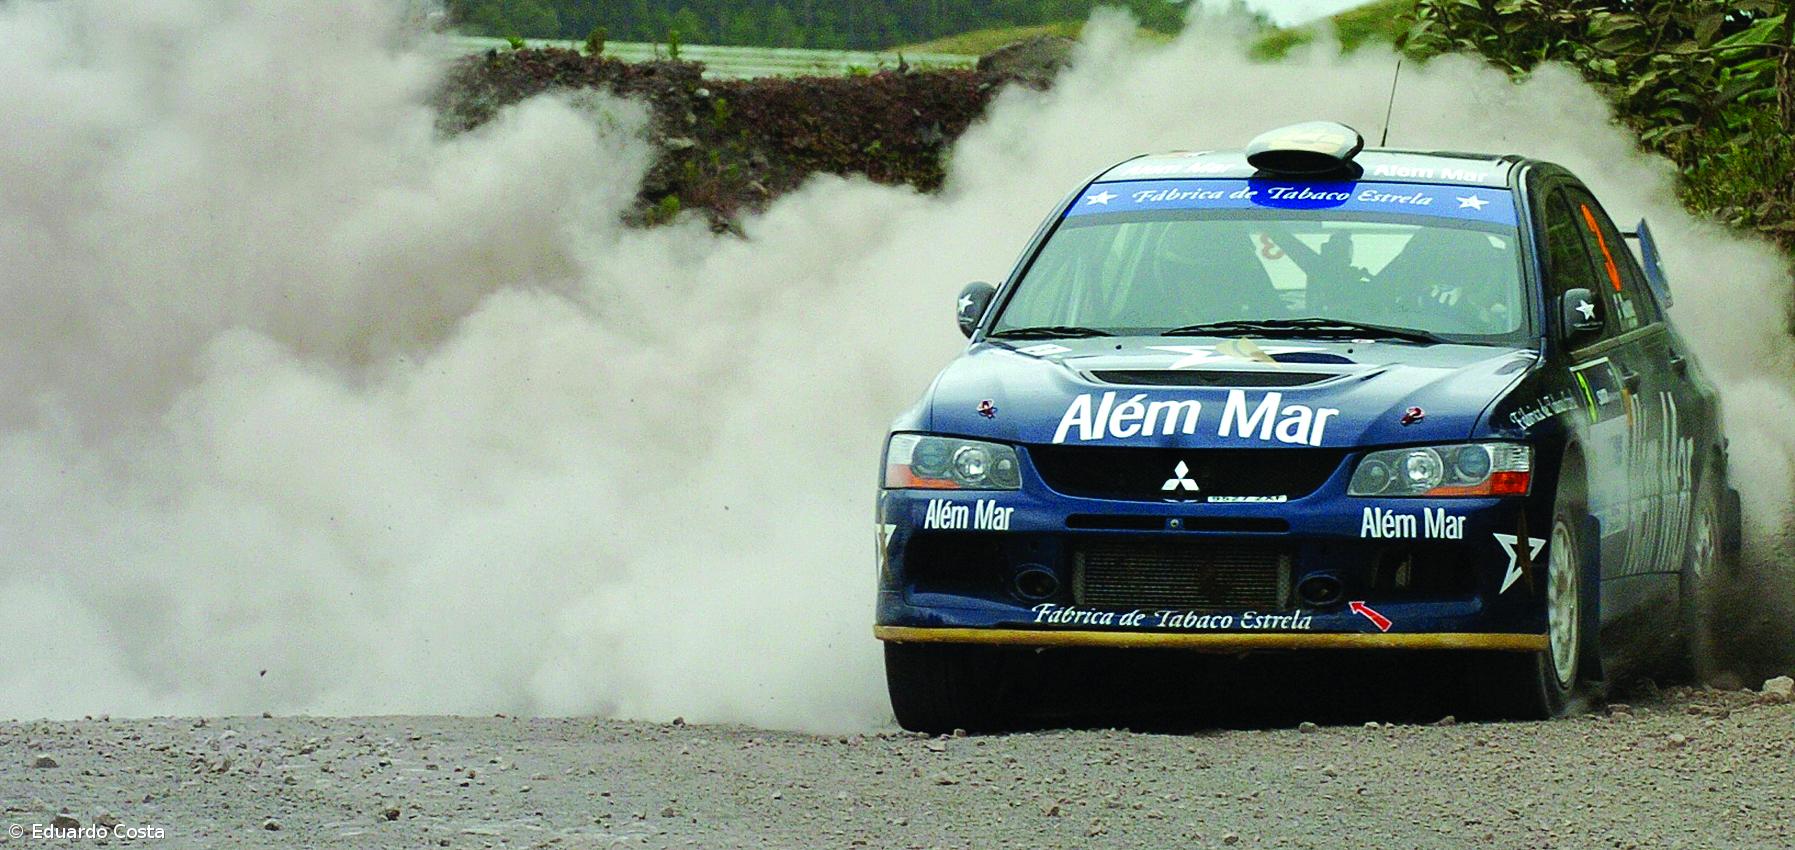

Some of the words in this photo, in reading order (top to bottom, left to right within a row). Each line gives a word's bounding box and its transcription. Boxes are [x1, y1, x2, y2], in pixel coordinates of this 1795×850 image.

[1440, 167, 1488, 182] Mar
[1132, 187, 1224, 203] Fábrica
[1229, 186, 1257, 201] de
[1268, 187, 1350, 202] Tabaco
[1357, 189, 1433, 206] Estrela
[1052, 391, 1201, 444] Além
[1218, 389, 1340, 446] Mar
[924, 498, 969, 529] Além
[974, 499, 1014, 531] Mar
[1361, 506, 1417, 538] Além
[1424, 507, 1467, 540] Mar
[1031, 602, 1115, 625] Fábrica
[1119, 608, 1146, 627] de
[1153, 609, 1233, 630] Tabaco
[1240, 608, 1313, 630] Estrela
